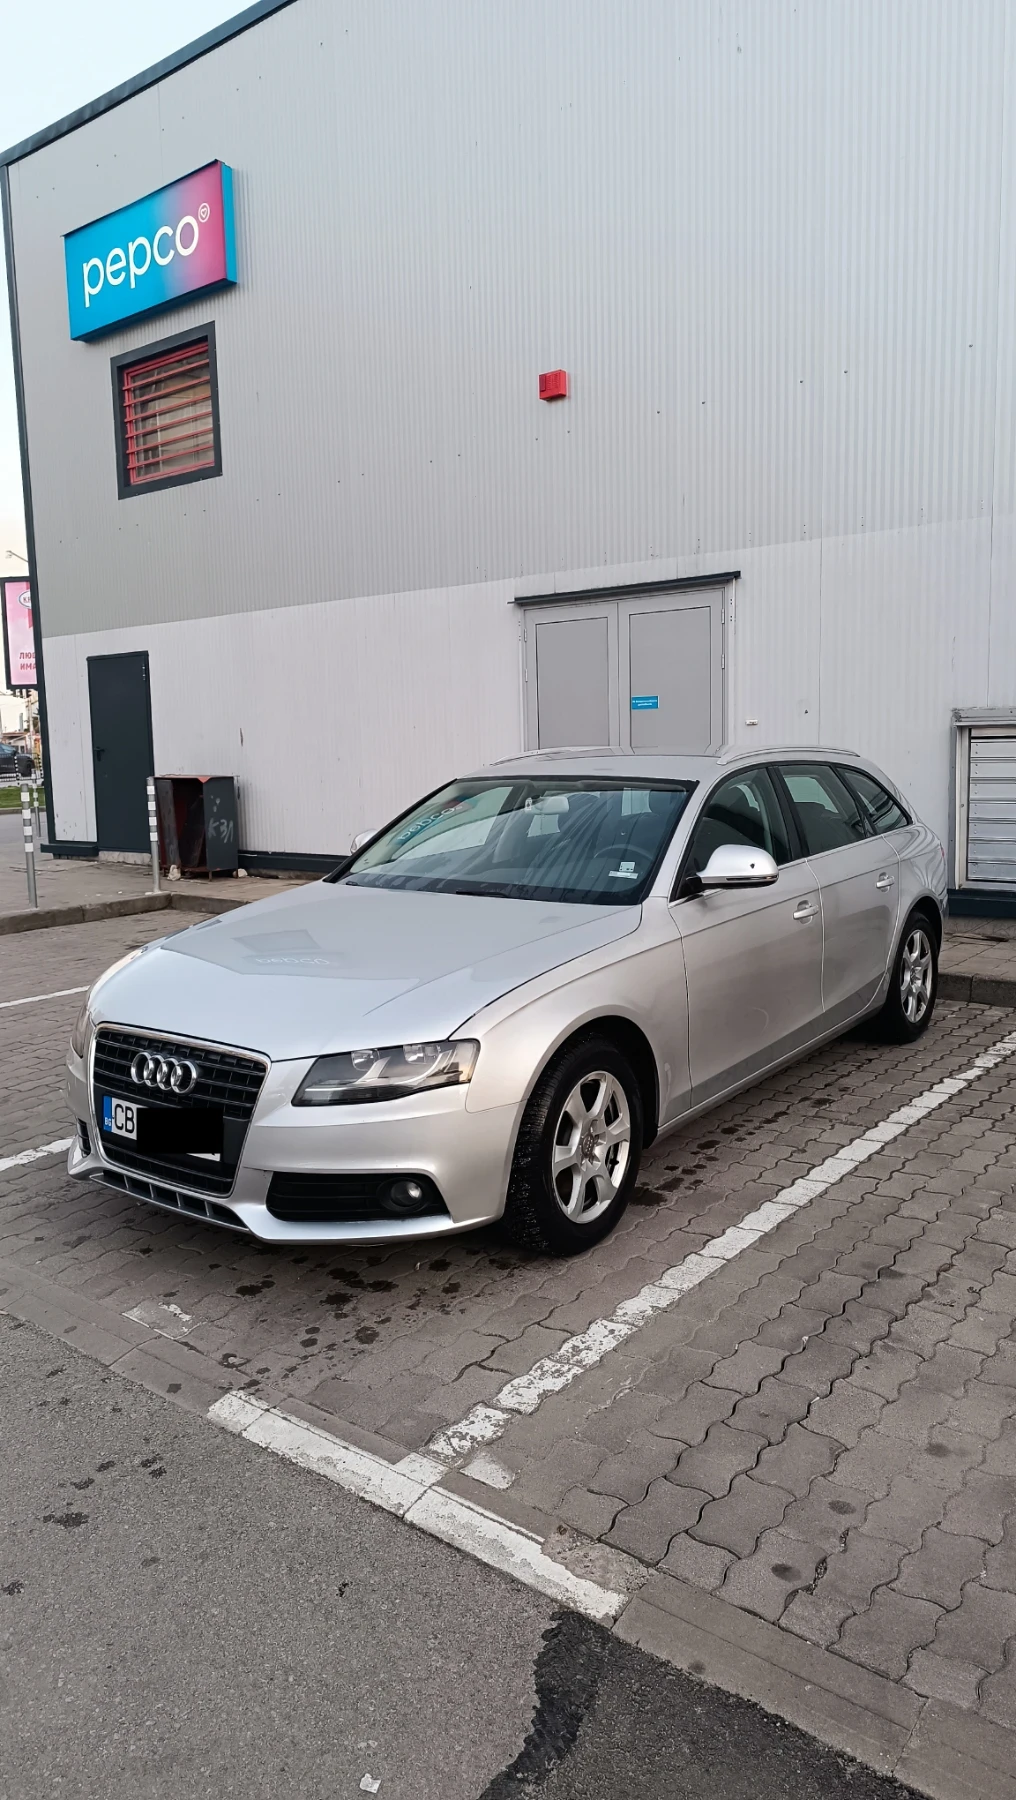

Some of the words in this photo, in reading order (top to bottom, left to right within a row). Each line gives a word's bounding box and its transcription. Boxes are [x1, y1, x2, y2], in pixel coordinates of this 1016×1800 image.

[82, 214, 200, 308] pepco
[104, 1116, 112, 1127] BG
[114, 1103, 135, 1134] CB
